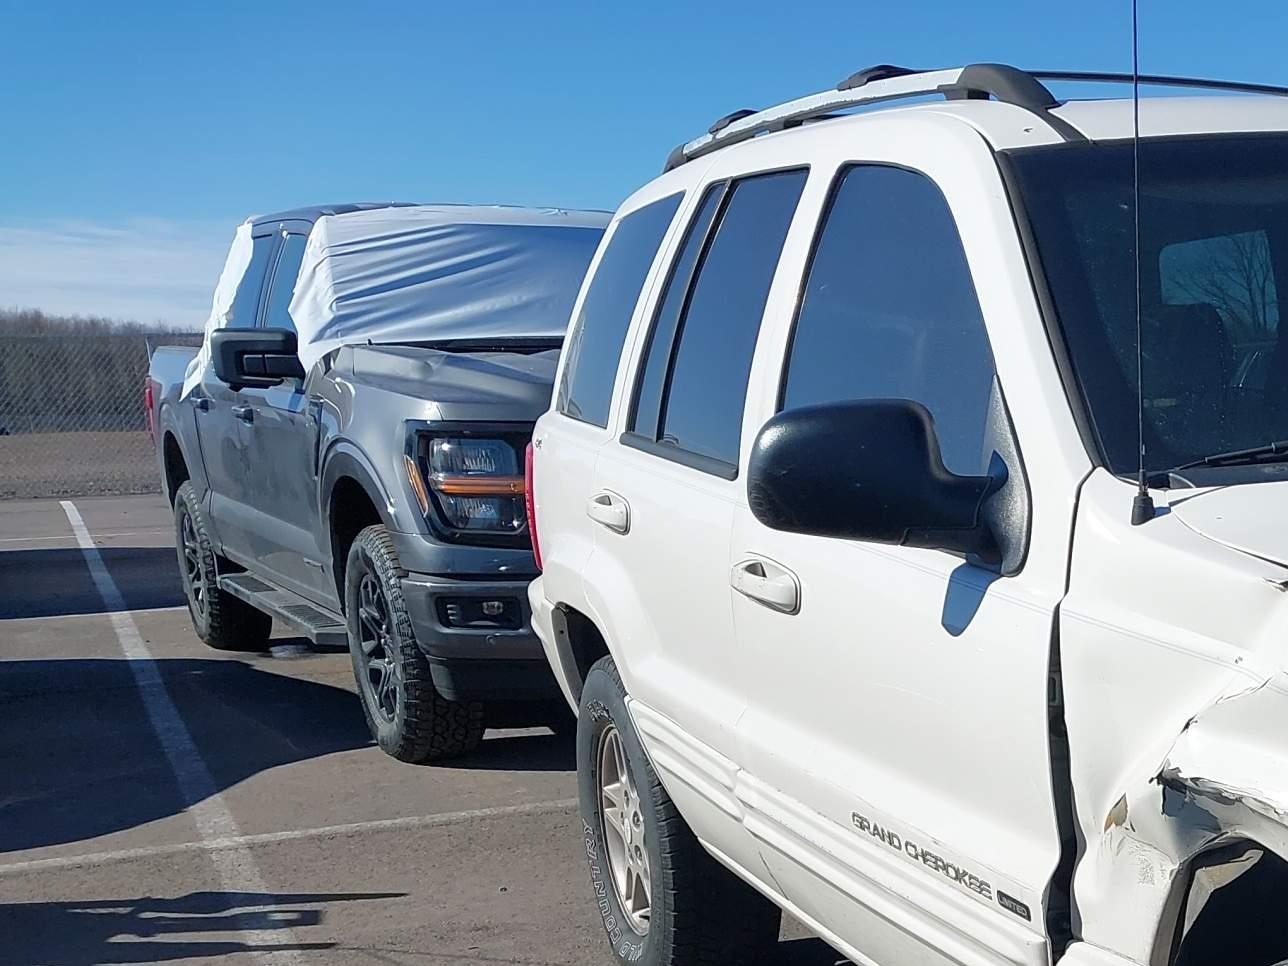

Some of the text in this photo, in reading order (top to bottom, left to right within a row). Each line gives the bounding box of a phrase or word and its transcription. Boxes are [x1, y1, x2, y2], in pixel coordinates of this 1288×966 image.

[582, 818, 621, 944] COUNTRY
[852, 812, 993, 901] GRAND CHEROKEE
